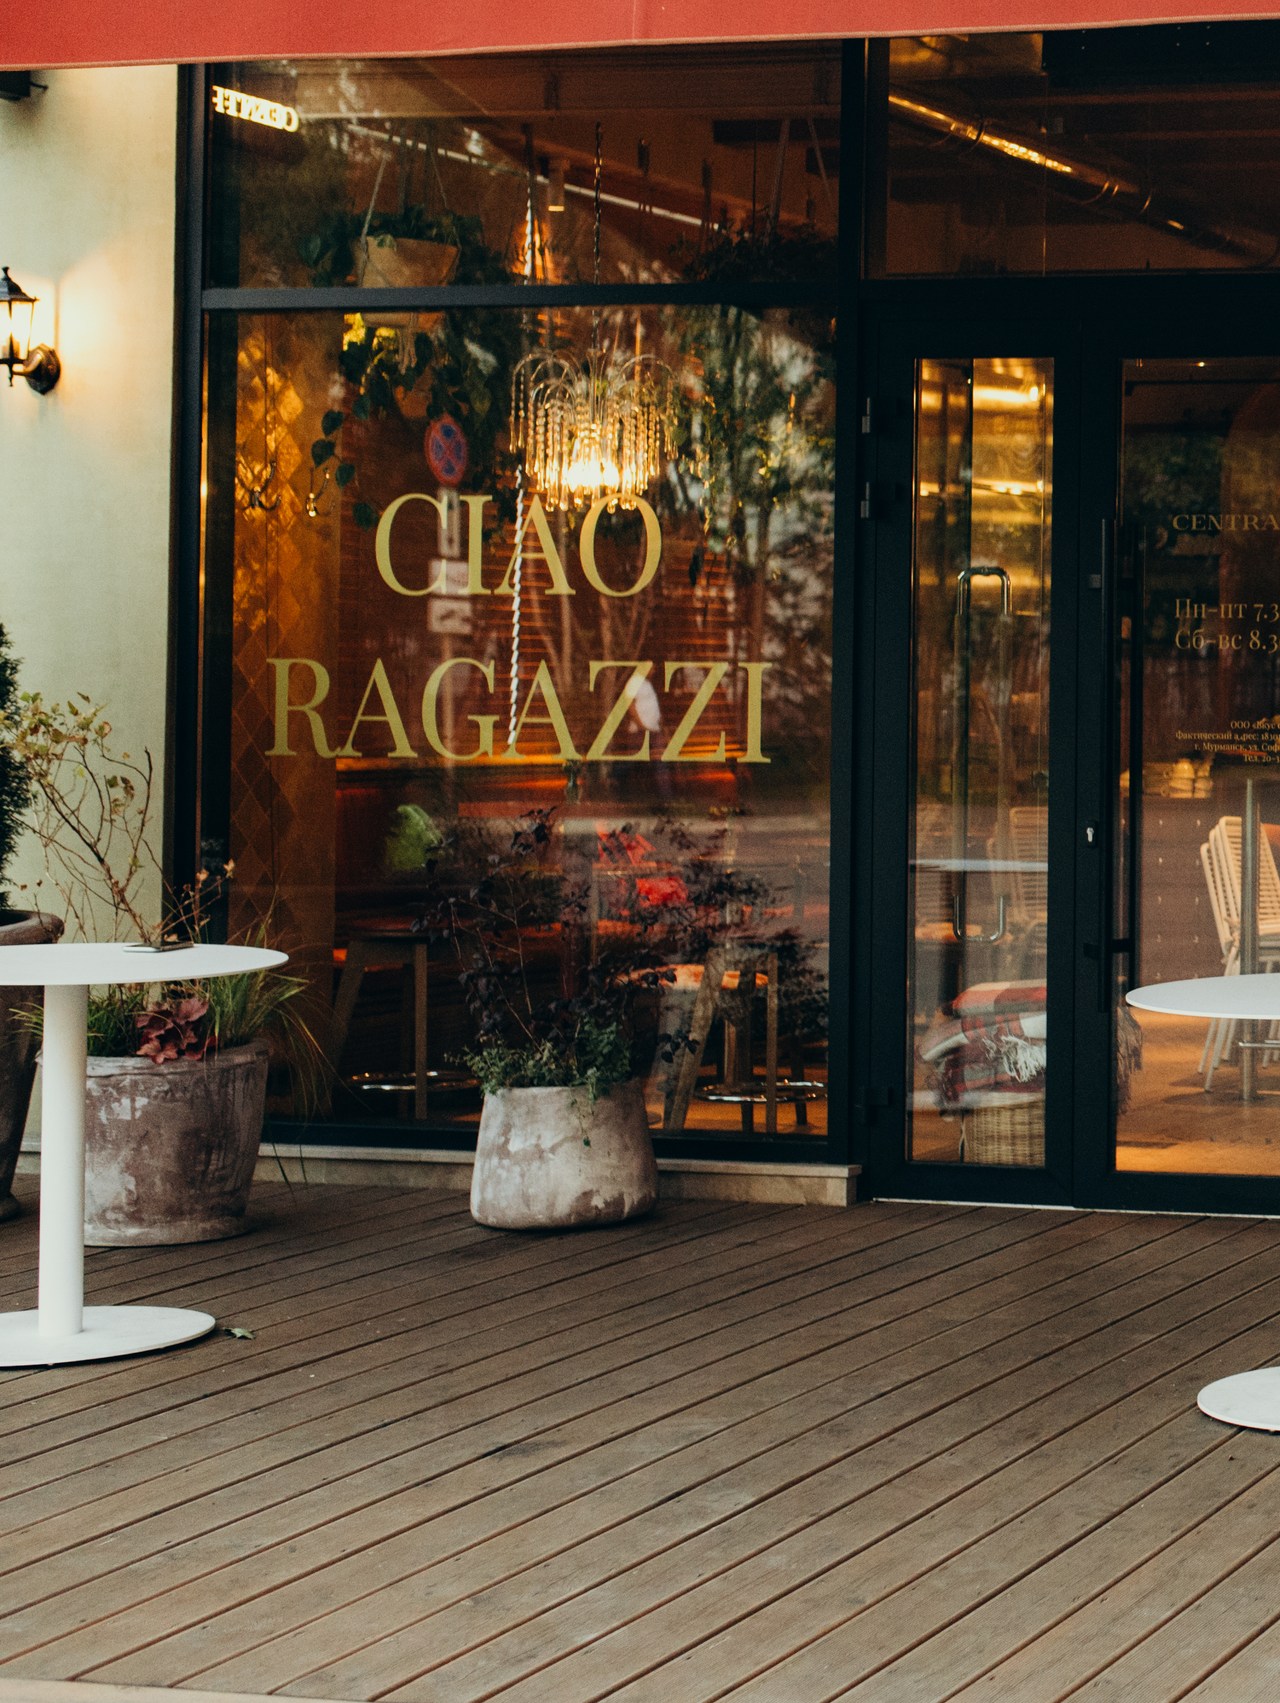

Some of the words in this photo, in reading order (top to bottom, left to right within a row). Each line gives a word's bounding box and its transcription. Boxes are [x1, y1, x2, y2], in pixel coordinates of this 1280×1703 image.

[375, 493, 662, 597] CIAO
[1175, 598, 1248, 619] Пн-пт
[1175, 628, 1242, 650] Сб-вс
[265, 658, 771, 763] RAGAZZI
[1175, 730, 1232, 740] Фактический
[1230, 721, 1250, 729] ООО
